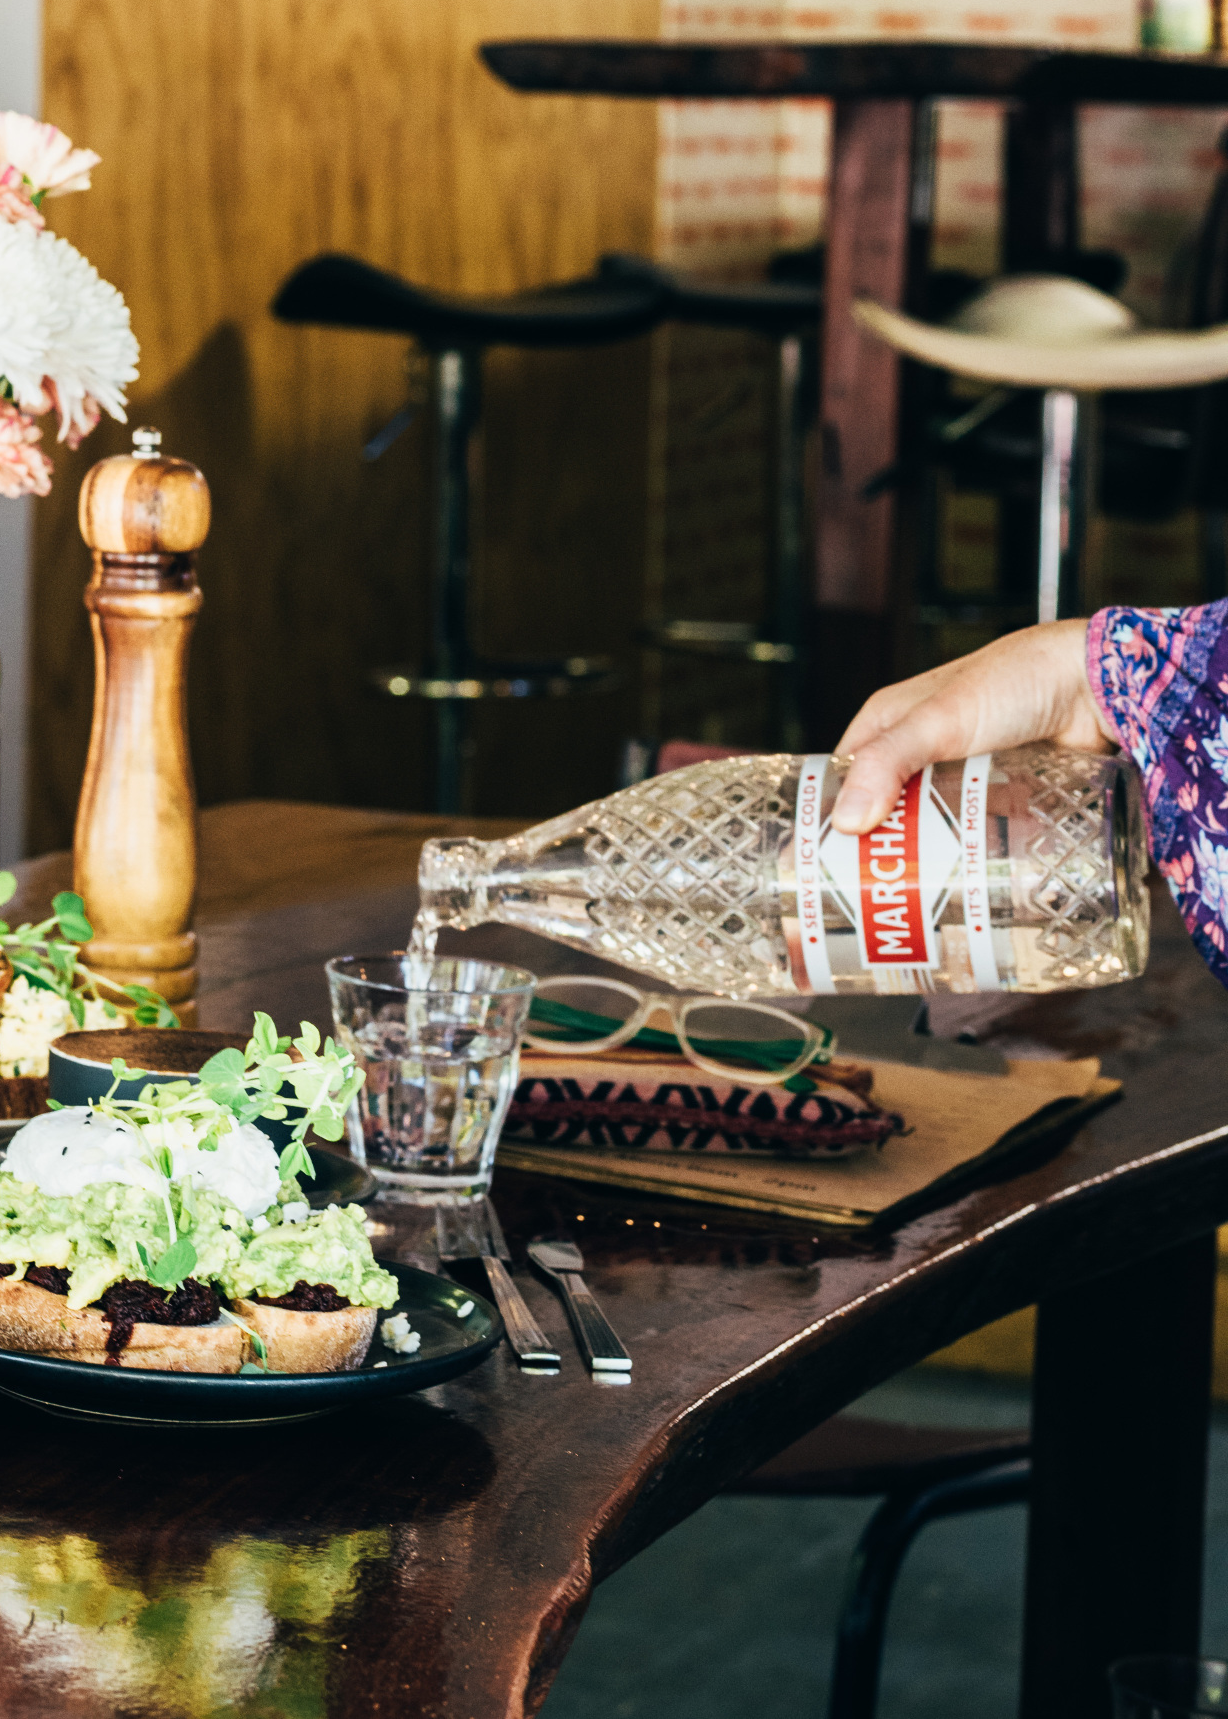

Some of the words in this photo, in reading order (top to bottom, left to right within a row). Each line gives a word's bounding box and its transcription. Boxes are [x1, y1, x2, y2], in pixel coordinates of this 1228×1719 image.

[801, 784, 817, 827] COLD
[966, 786, 980, 830] MOST
[800, 836, 815, 866] ICY
[966, 839, 980, 875] THE
[801, 874, 819, 929] SERVE
[968, 886, 982, 918] IT'S
